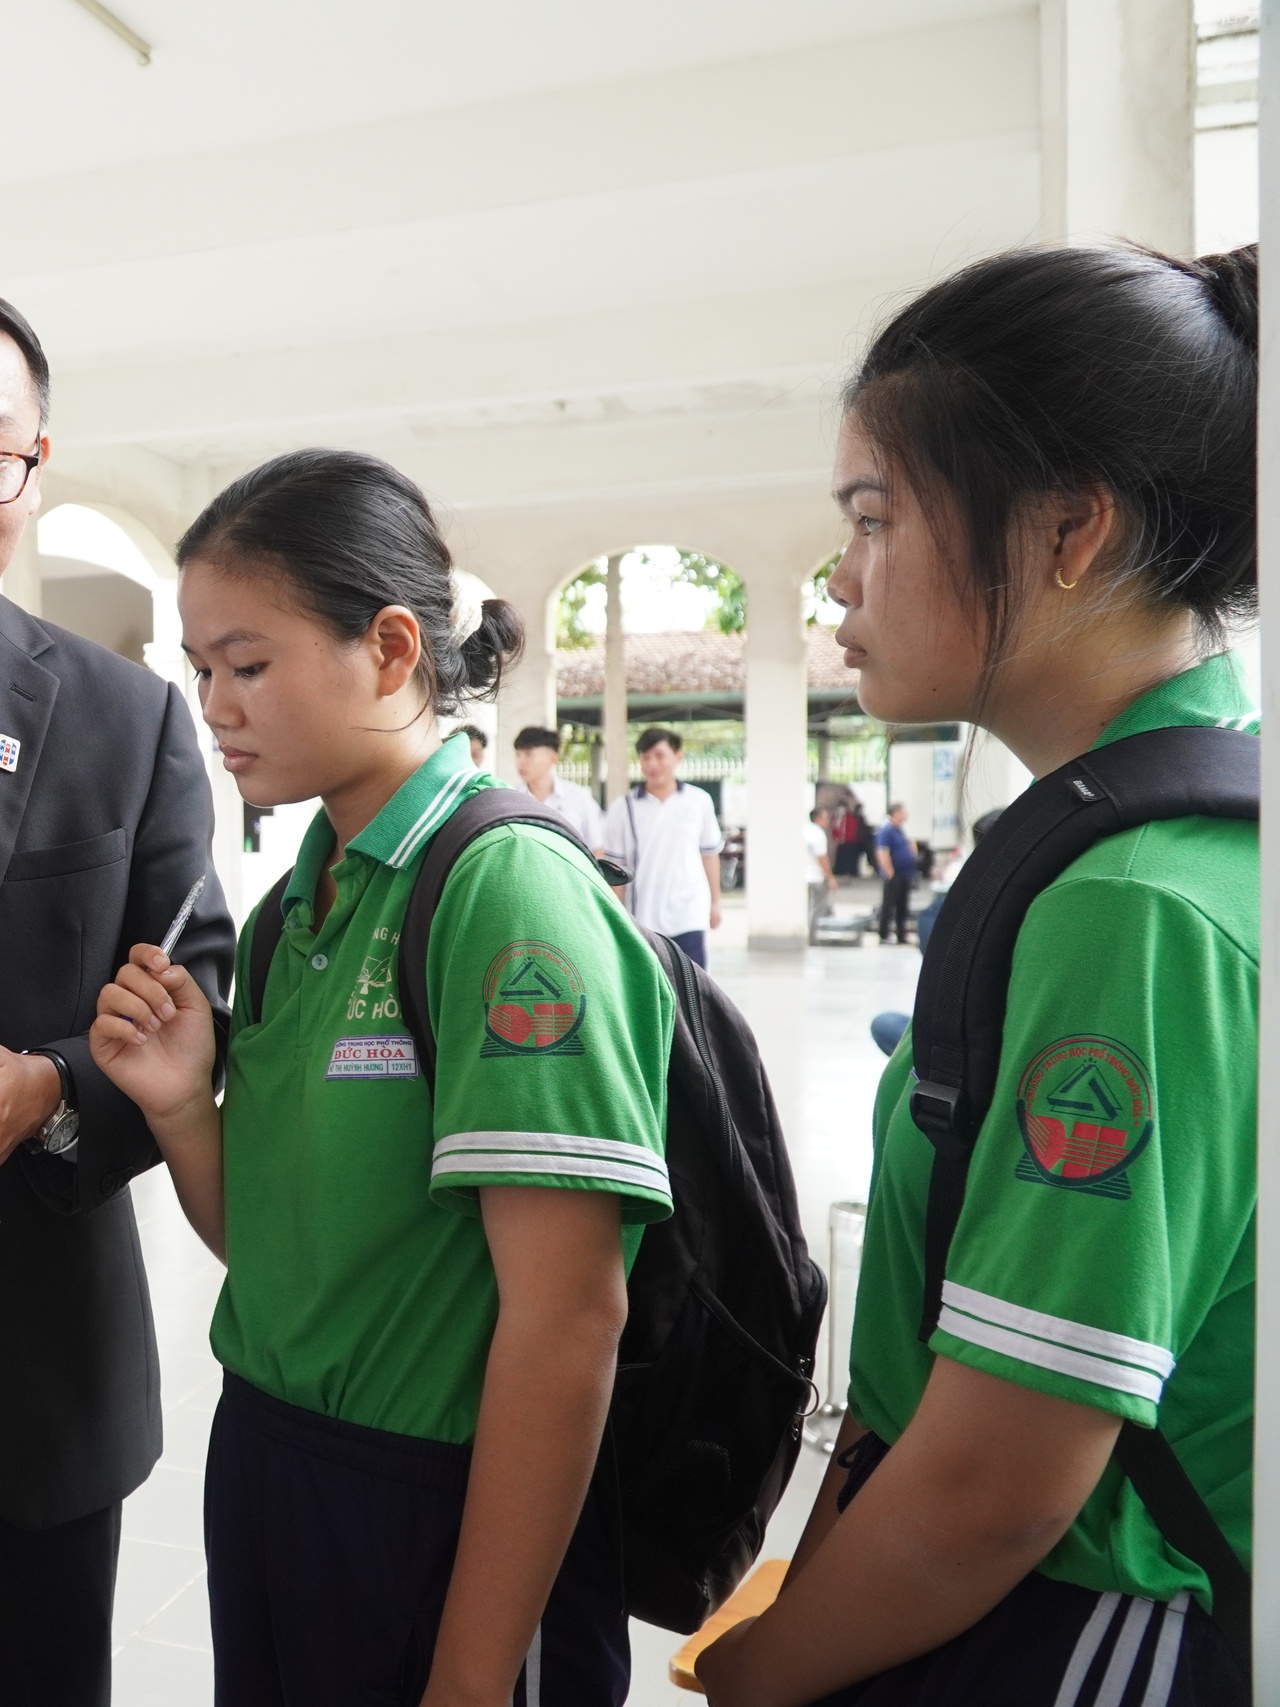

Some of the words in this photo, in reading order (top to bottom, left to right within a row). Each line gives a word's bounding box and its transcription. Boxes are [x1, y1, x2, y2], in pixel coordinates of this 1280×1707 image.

[334, 1046, 361, 1059] ĐỨC
[366, 1045, 405, 1059] HÒA
[343, 1062, 361, 1072] HUỲNH
[391, 1063, 412, 1071] 12XH1
[1042, 1050, 1068, 1071] TRUNG
